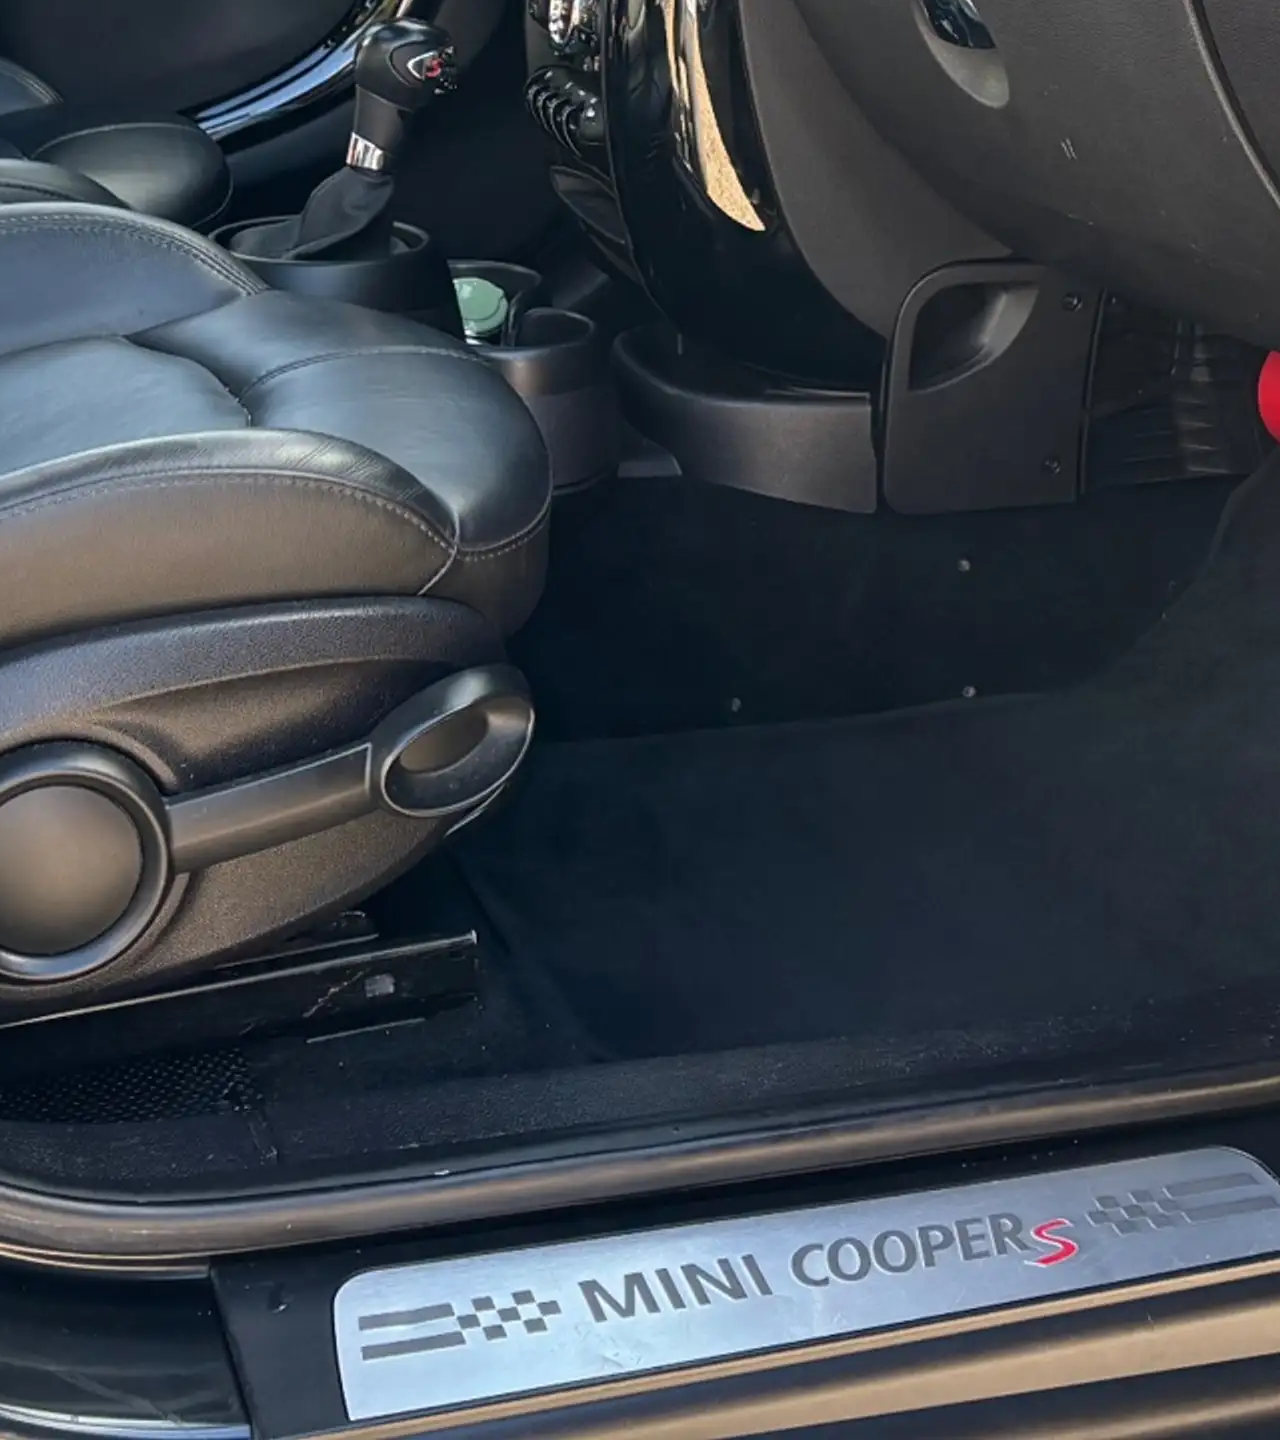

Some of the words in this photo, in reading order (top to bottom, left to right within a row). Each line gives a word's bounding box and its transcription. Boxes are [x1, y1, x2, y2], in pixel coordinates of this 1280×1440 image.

[578, 1253, 773, 1324] MINI
[790, 1212, 1030, 1288] COOPER
[1024, 1217, 1080, 1267] S
